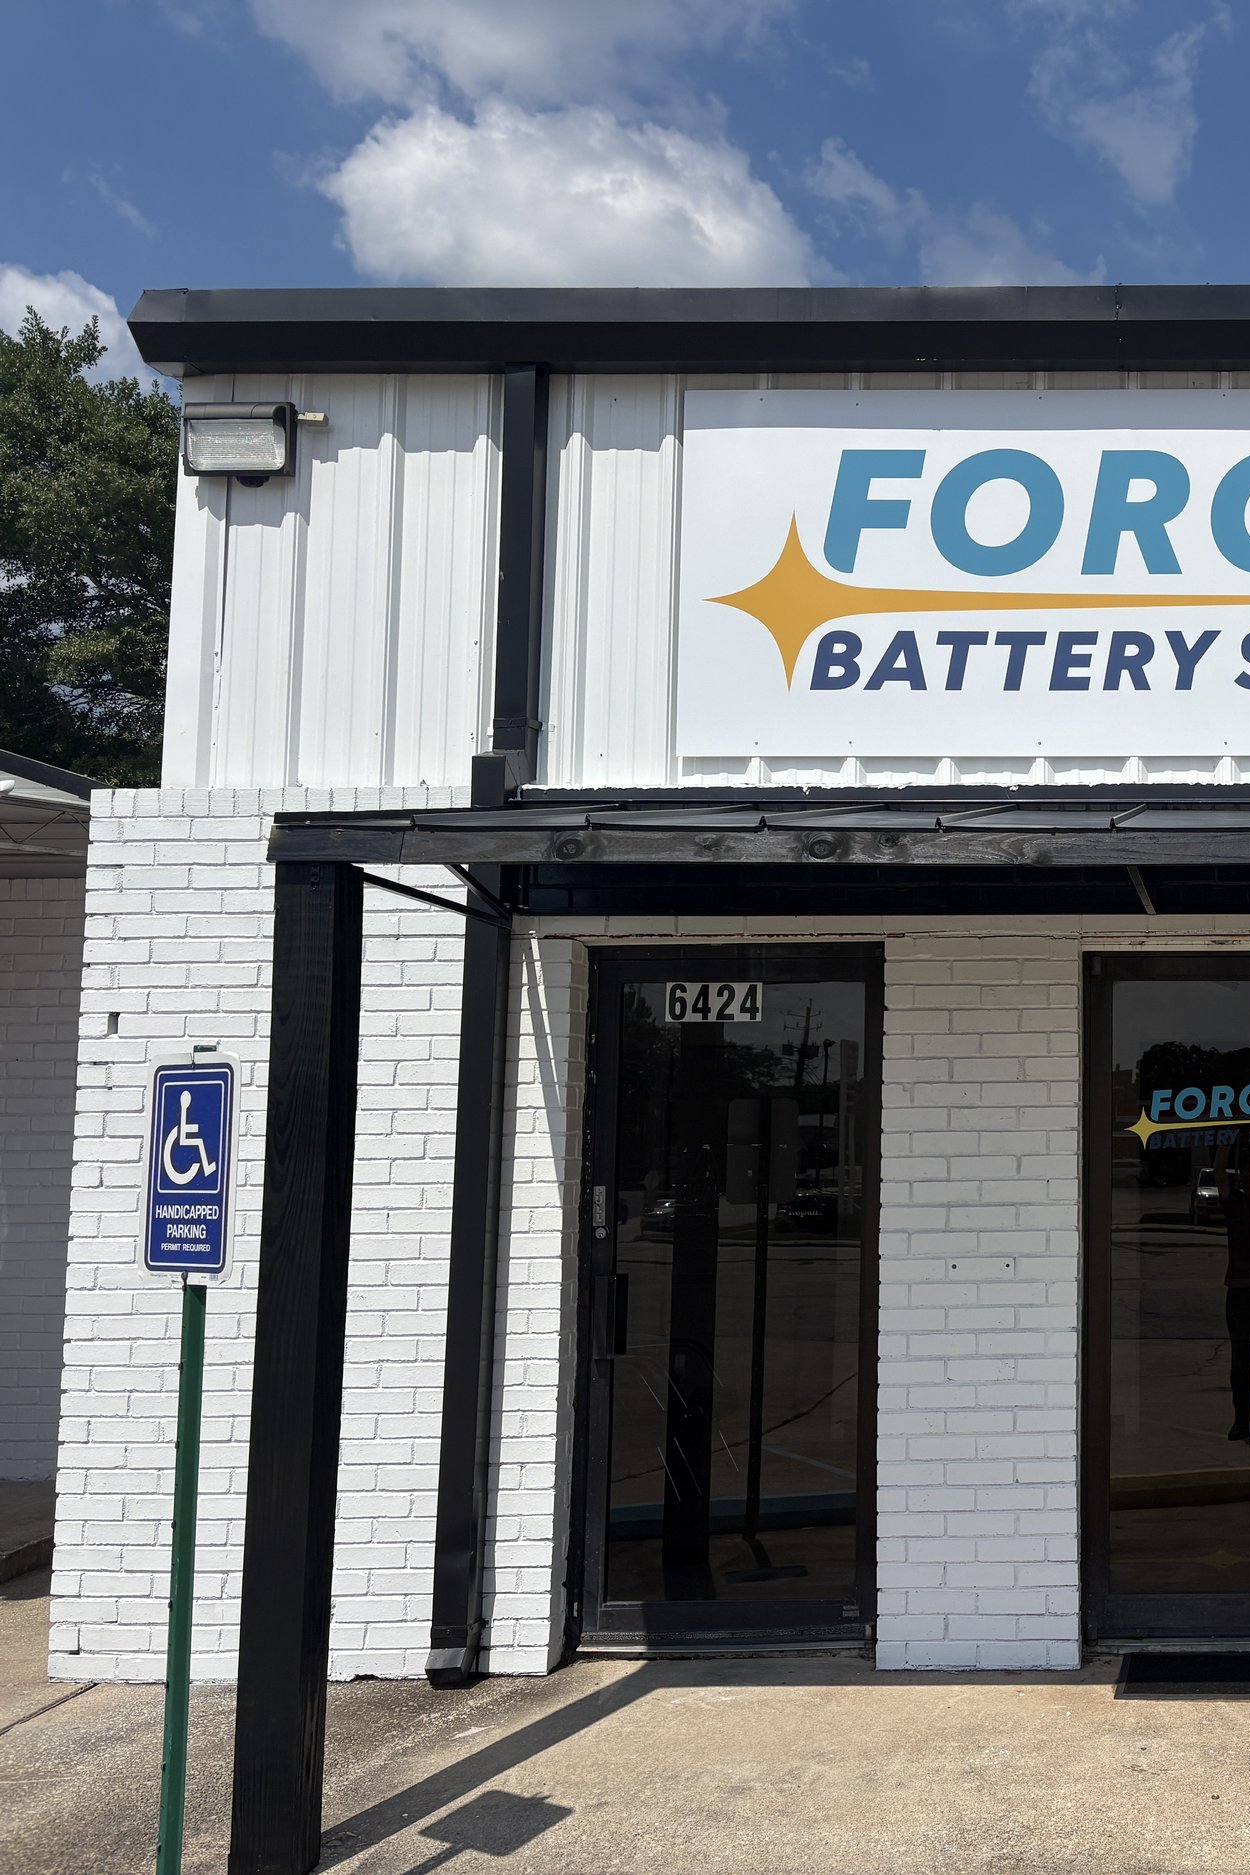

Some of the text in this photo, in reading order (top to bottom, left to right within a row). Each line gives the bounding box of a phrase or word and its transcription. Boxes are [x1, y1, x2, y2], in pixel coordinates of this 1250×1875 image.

[809, 628, 1221, 691] BATTERY
[668, 983, 760, 1021] 6424
[1150, 1129, 1240, 1150] BATTERY
[155, 1205, 219, 1219] HANDICAPPED
[166, 1224, 207, 1239] PARKING
[161, 1243, 211, 1252] PERMIT REQUIRED
